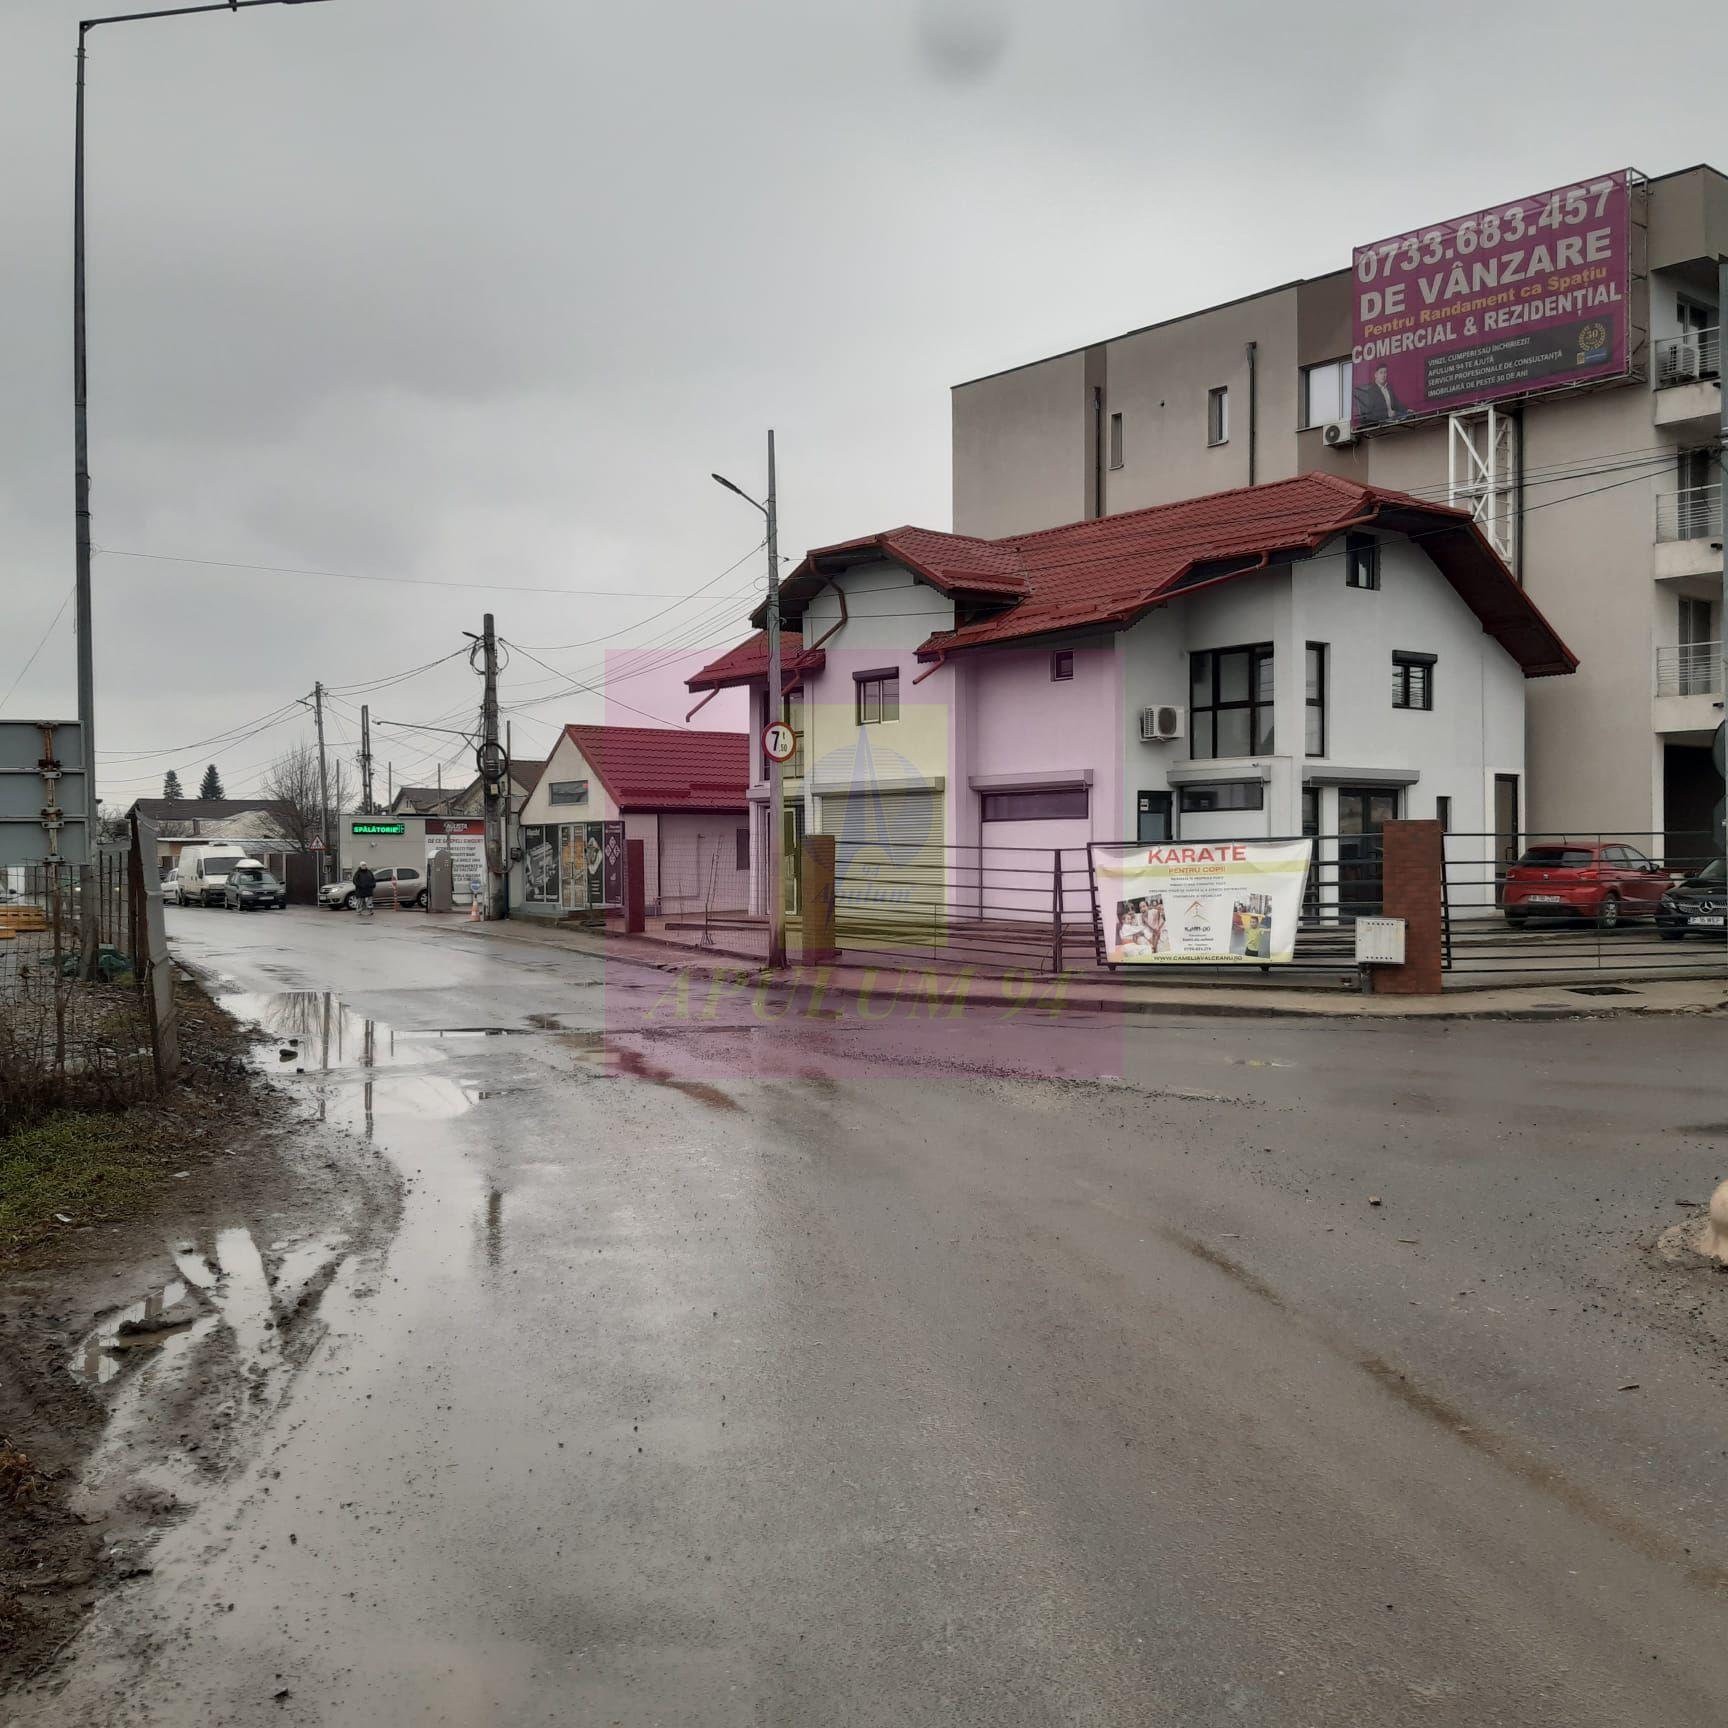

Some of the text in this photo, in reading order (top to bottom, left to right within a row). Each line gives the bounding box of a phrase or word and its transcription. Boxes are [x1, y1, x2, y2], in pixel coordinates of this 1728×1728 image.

[1358, 180, 1614, 283] 0733.683.457
[1360, 227, 1612, 322] DE VÂNZARE
[1364, 314, 1415, 337] Pentru
[1420, 287, 1515, 325] Randament
[1520, 282, 1543, 298] ca
[1352, 324, 1457, 364] COMERCIAL
[1463, 317, 1477, 336] &
[1477, 347, 1491, 355] SAU
[1428, 366, 1455, 377] APULUM
[1454, 365, 1503, 380] PROFESIONALE
[1476, 375, 1496, 386] PESTE
[1506, 372, 1515, 380] DE
[771, 730, 780, 752] 7
[1148, 846, 1248, 865] KARATE
[1168, 867, 1200, 875] PENTRU
